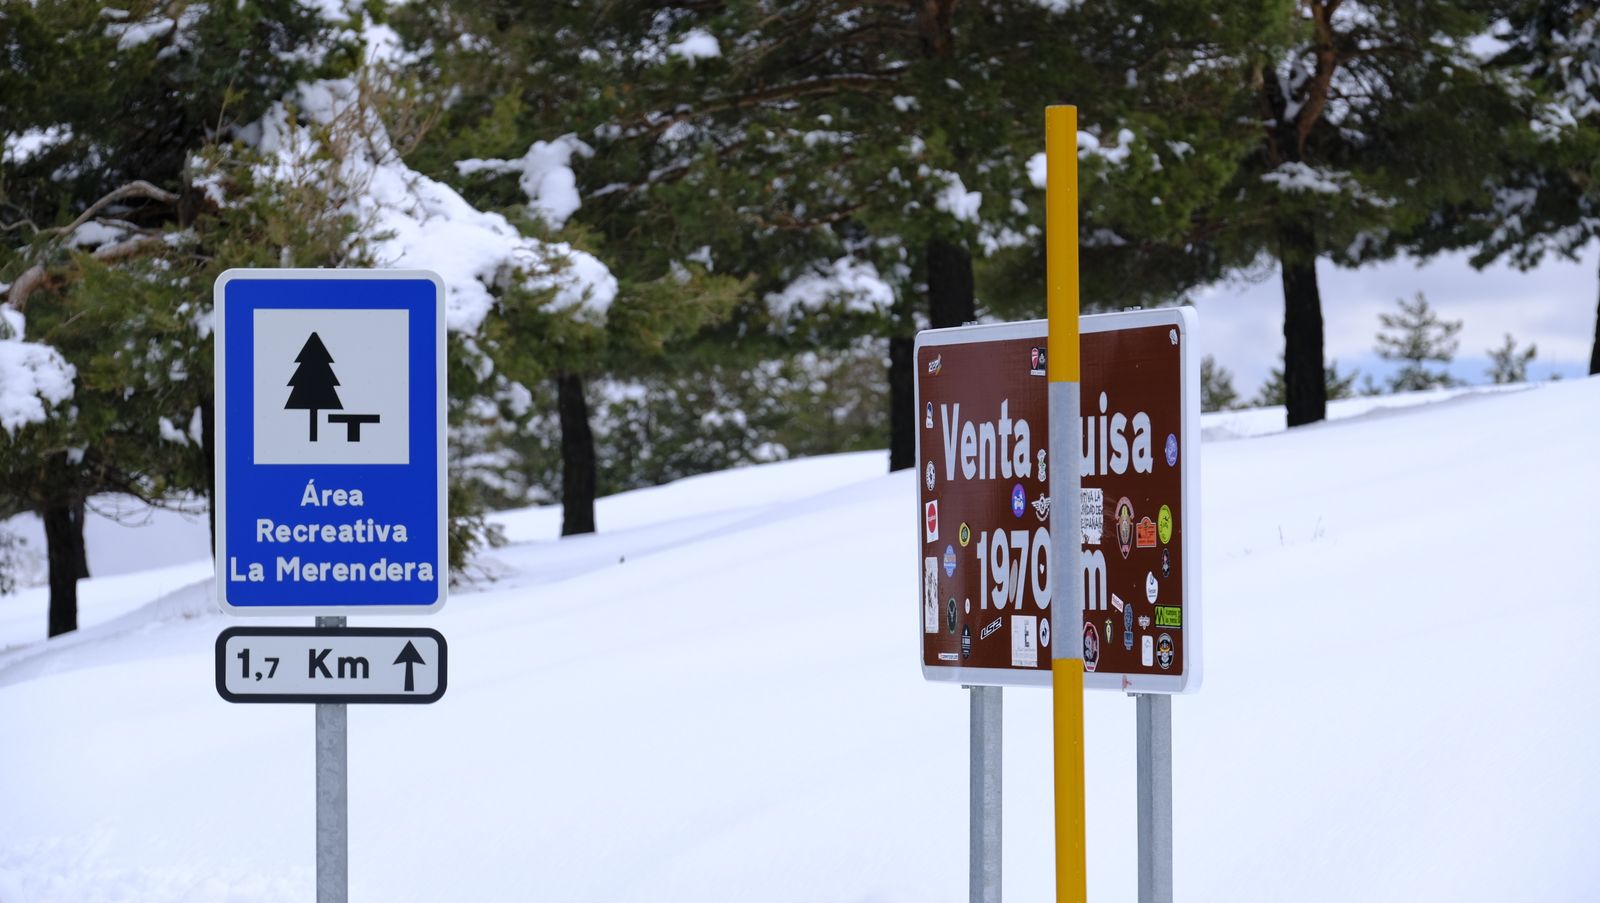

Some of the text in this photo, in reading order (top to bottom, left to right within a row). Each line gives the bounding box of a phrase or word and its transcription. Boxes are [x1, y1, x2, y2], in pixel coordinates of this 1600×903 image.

[940, 391, 1153, 481] Venta uisa
[300, 479, 364, 507] Área
[256, 518, 408, 544] Recreativa
[230, 556, 434, 583] La Merendera
[976, 526, 1107, 610] 1970 m
[237, 648, 370, 682] 1,7 Km
